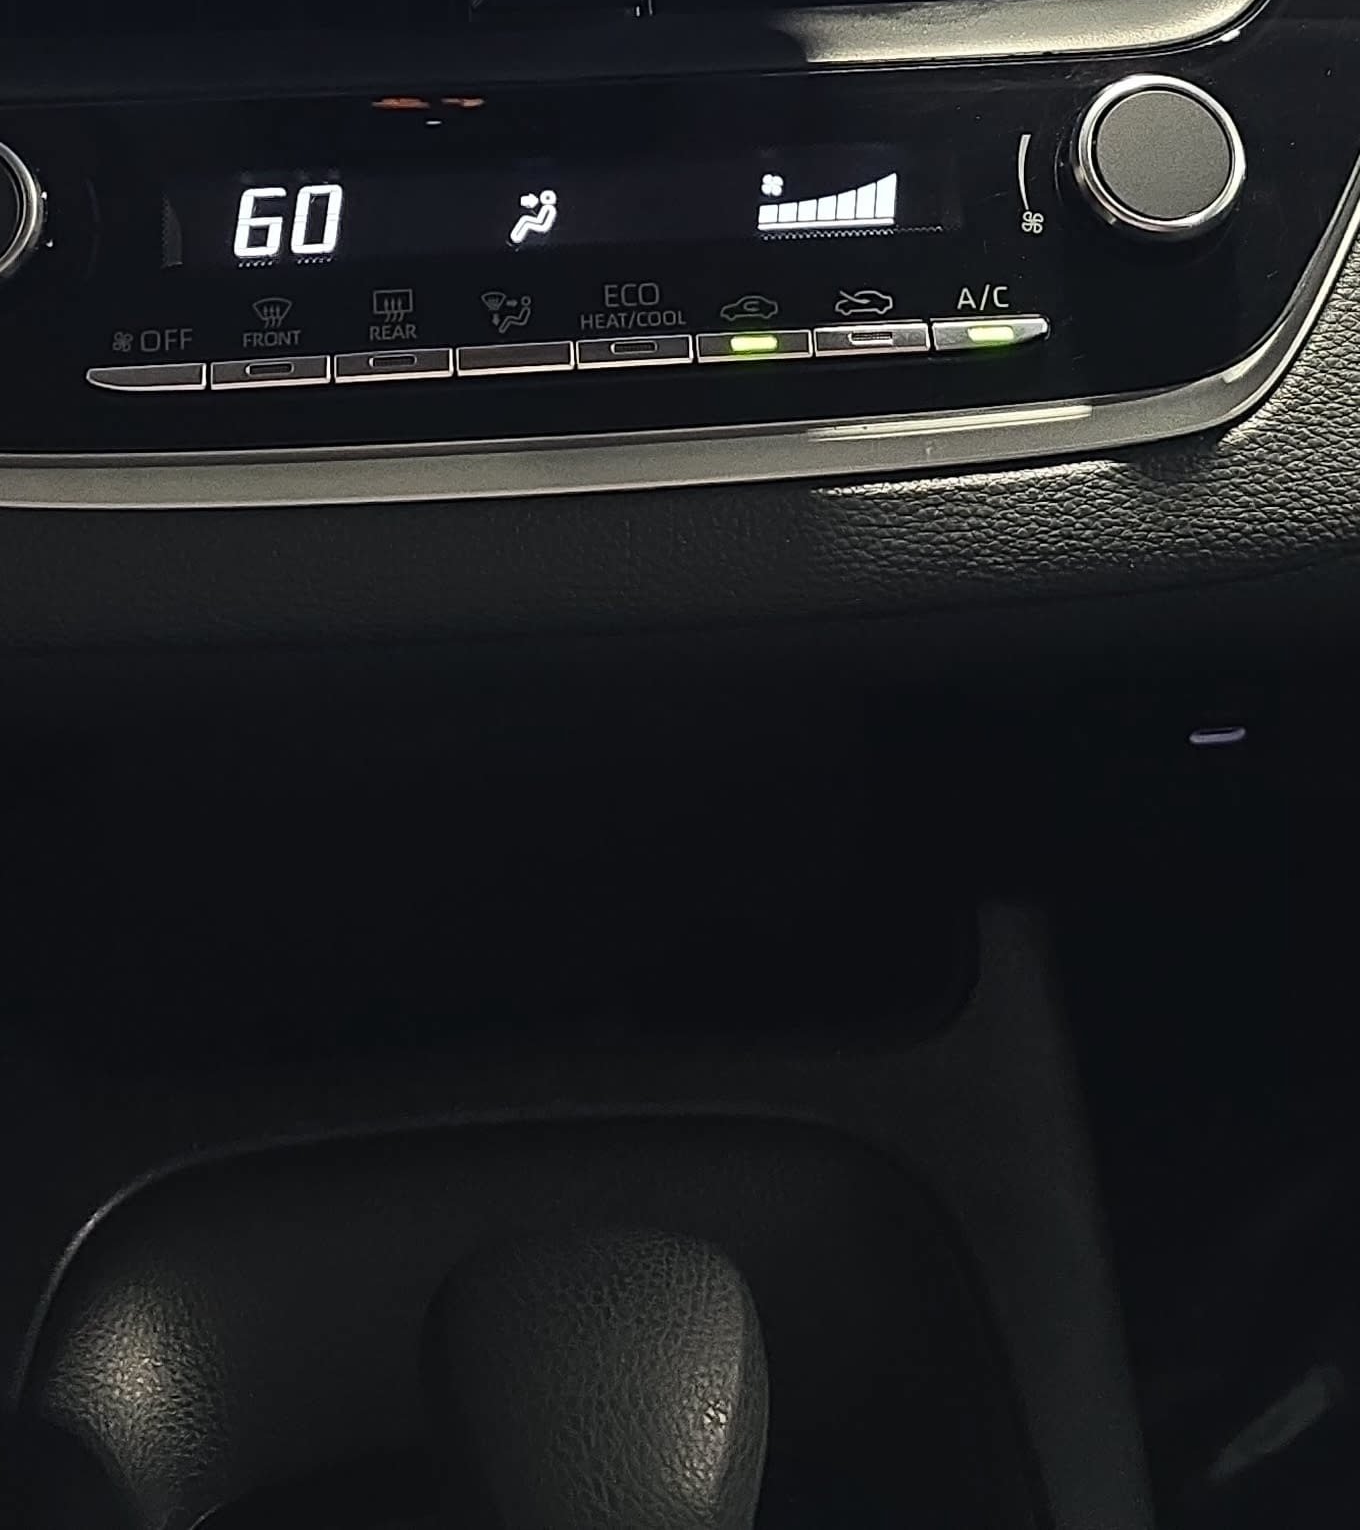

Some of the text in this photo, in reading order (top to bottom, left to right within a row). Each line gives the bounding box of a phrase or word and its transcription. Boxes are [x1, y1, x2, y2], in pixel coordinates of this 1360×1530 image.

[233, 183, 344, 259] 60
[603, 282, 661, 309] ECO
[956, 284, 1010, 312] A/C
[368, 323, 418, 342] REAR
[580, 309, 687, 331] HEAT/COOL
[140, 328, 194, 353] OFF
[242, 328, 301, 349] FRONT
